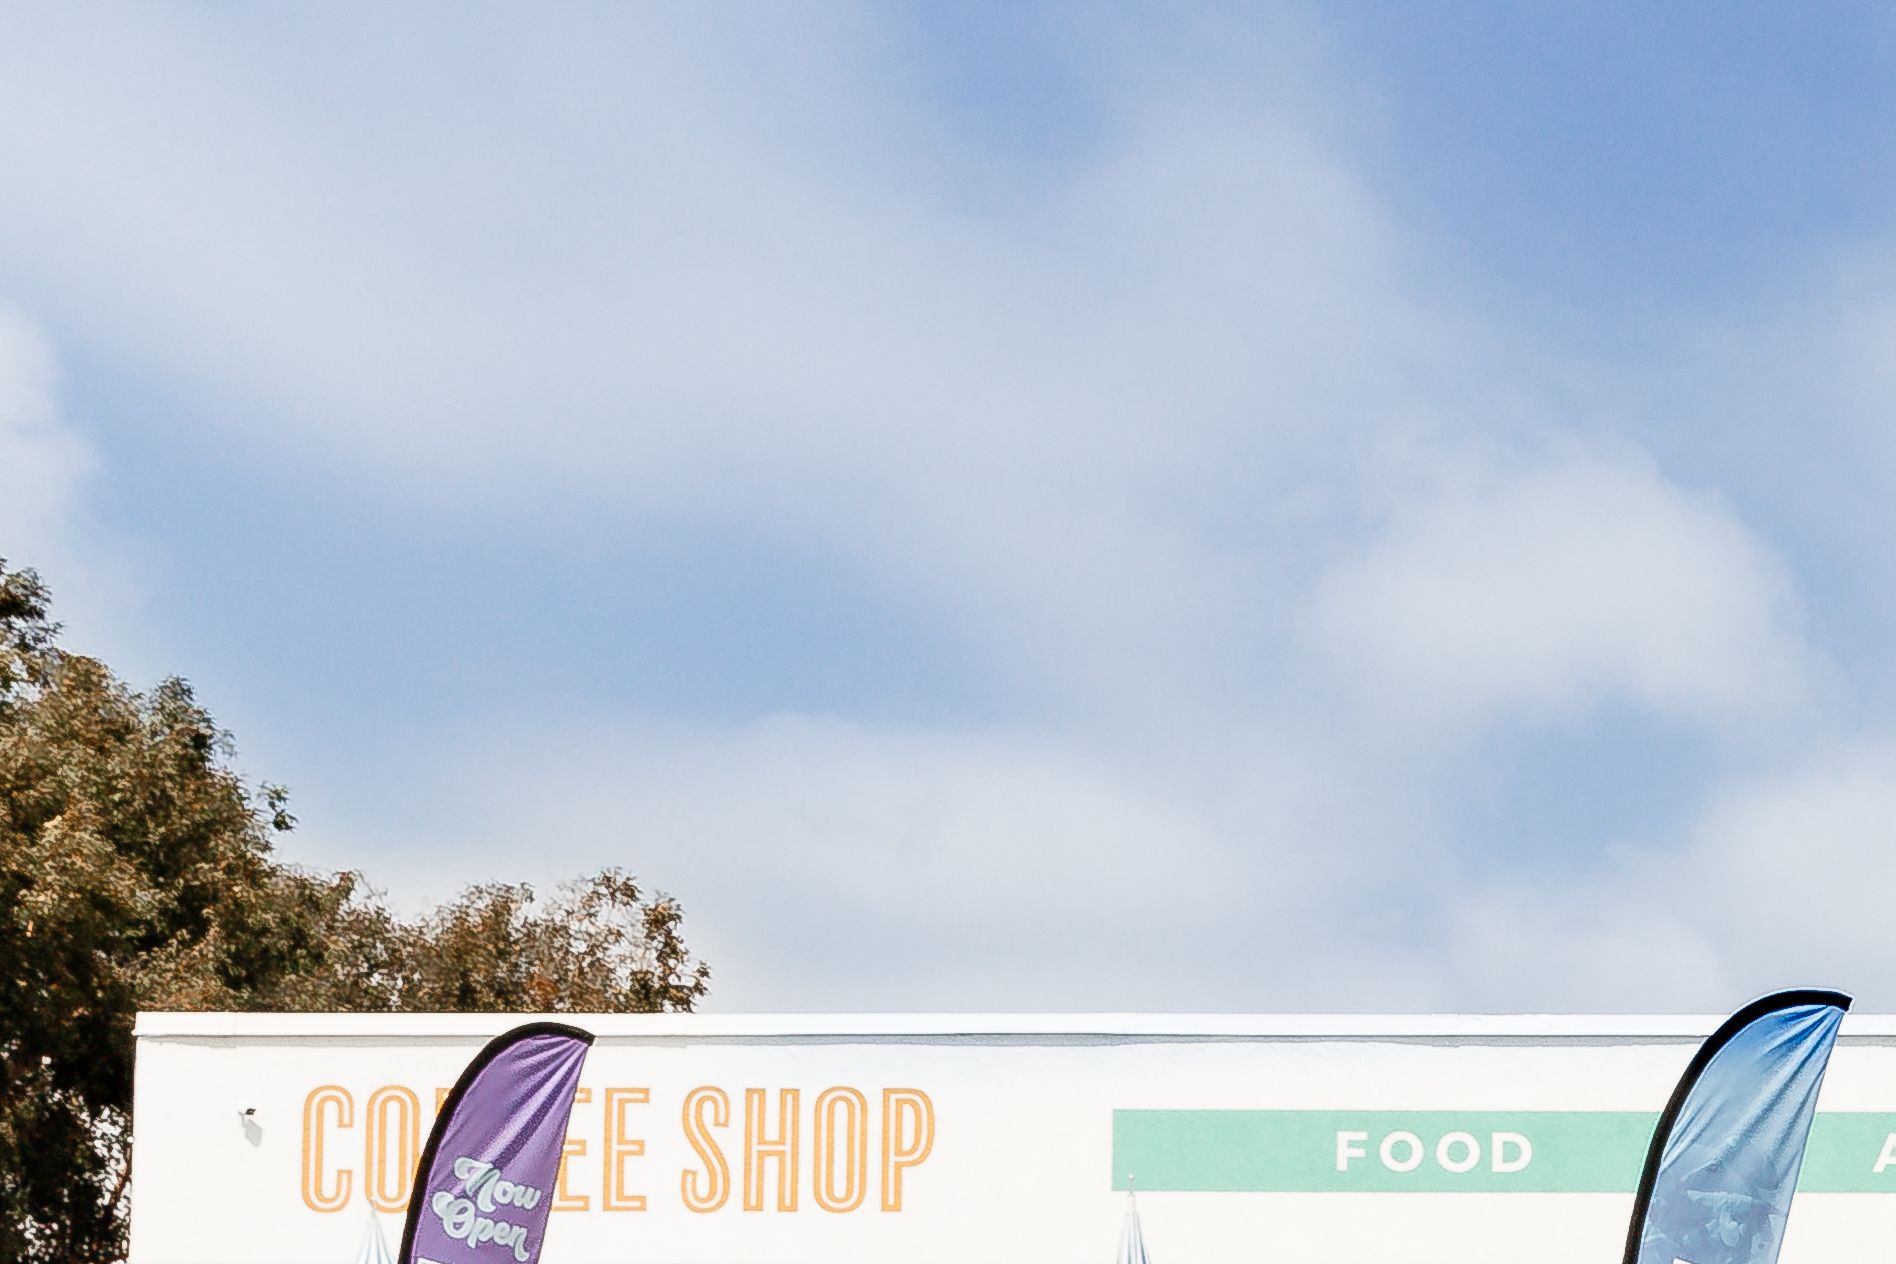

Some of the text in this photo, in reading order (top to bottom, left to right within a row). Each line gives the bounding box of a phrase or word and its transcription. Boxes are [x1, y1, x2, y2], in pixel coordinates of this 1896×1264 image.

[301, 1085, 935, 1213] COEE SHOP
[1335, 1130, 1535, 1173] FOOD
[454, 1157, 541, 1212] Now
[432, 1190, 530, 1262] Open
